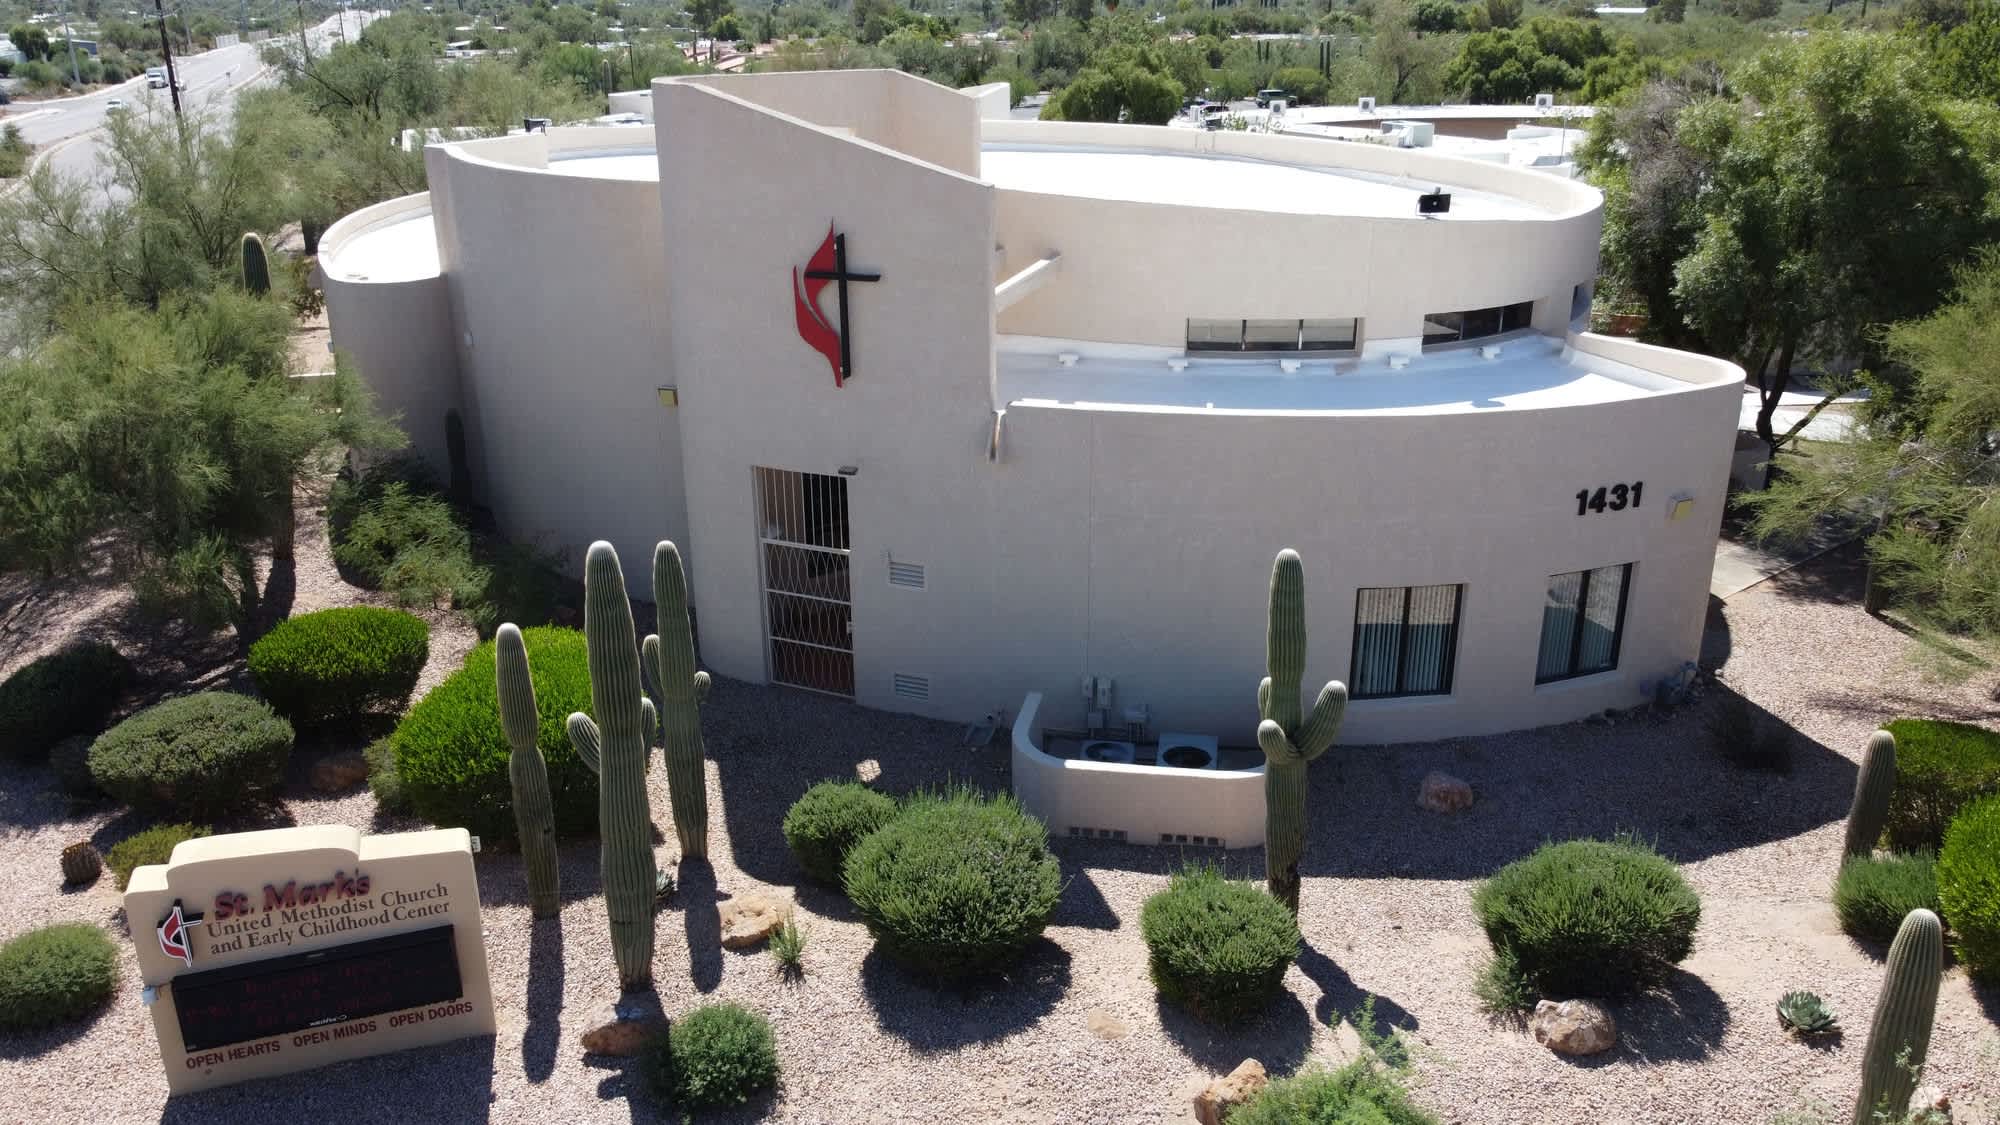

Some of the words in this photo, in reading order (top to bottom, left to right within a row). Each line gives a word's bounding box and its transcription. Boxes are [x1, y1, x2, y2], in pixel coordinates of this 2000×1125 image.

[1575, 481, 1644, 516] 1431
[207, 913, 271, 938] United
[281, 898, 375, 925] Methodist
[380, 883, 449, 907] Church
[262, 867, 370, 912] Mark's
[210, 936, 242, 955] and
[246, 927, 294, 946] Early
[298, 909, 391, 938] Childhood
[392, 902, 450, 921] Center
[186, 1052, 224, 1070] OPEN
[228, 1040, 281, 1061] HEARTS
[293, 1031, 330, 1048] OPEN
[333, 1021, 377, 1040] MINDS
[389, 1011, 425, 1028] OPEN
[428, 1002, 473, 1020] DOORS
